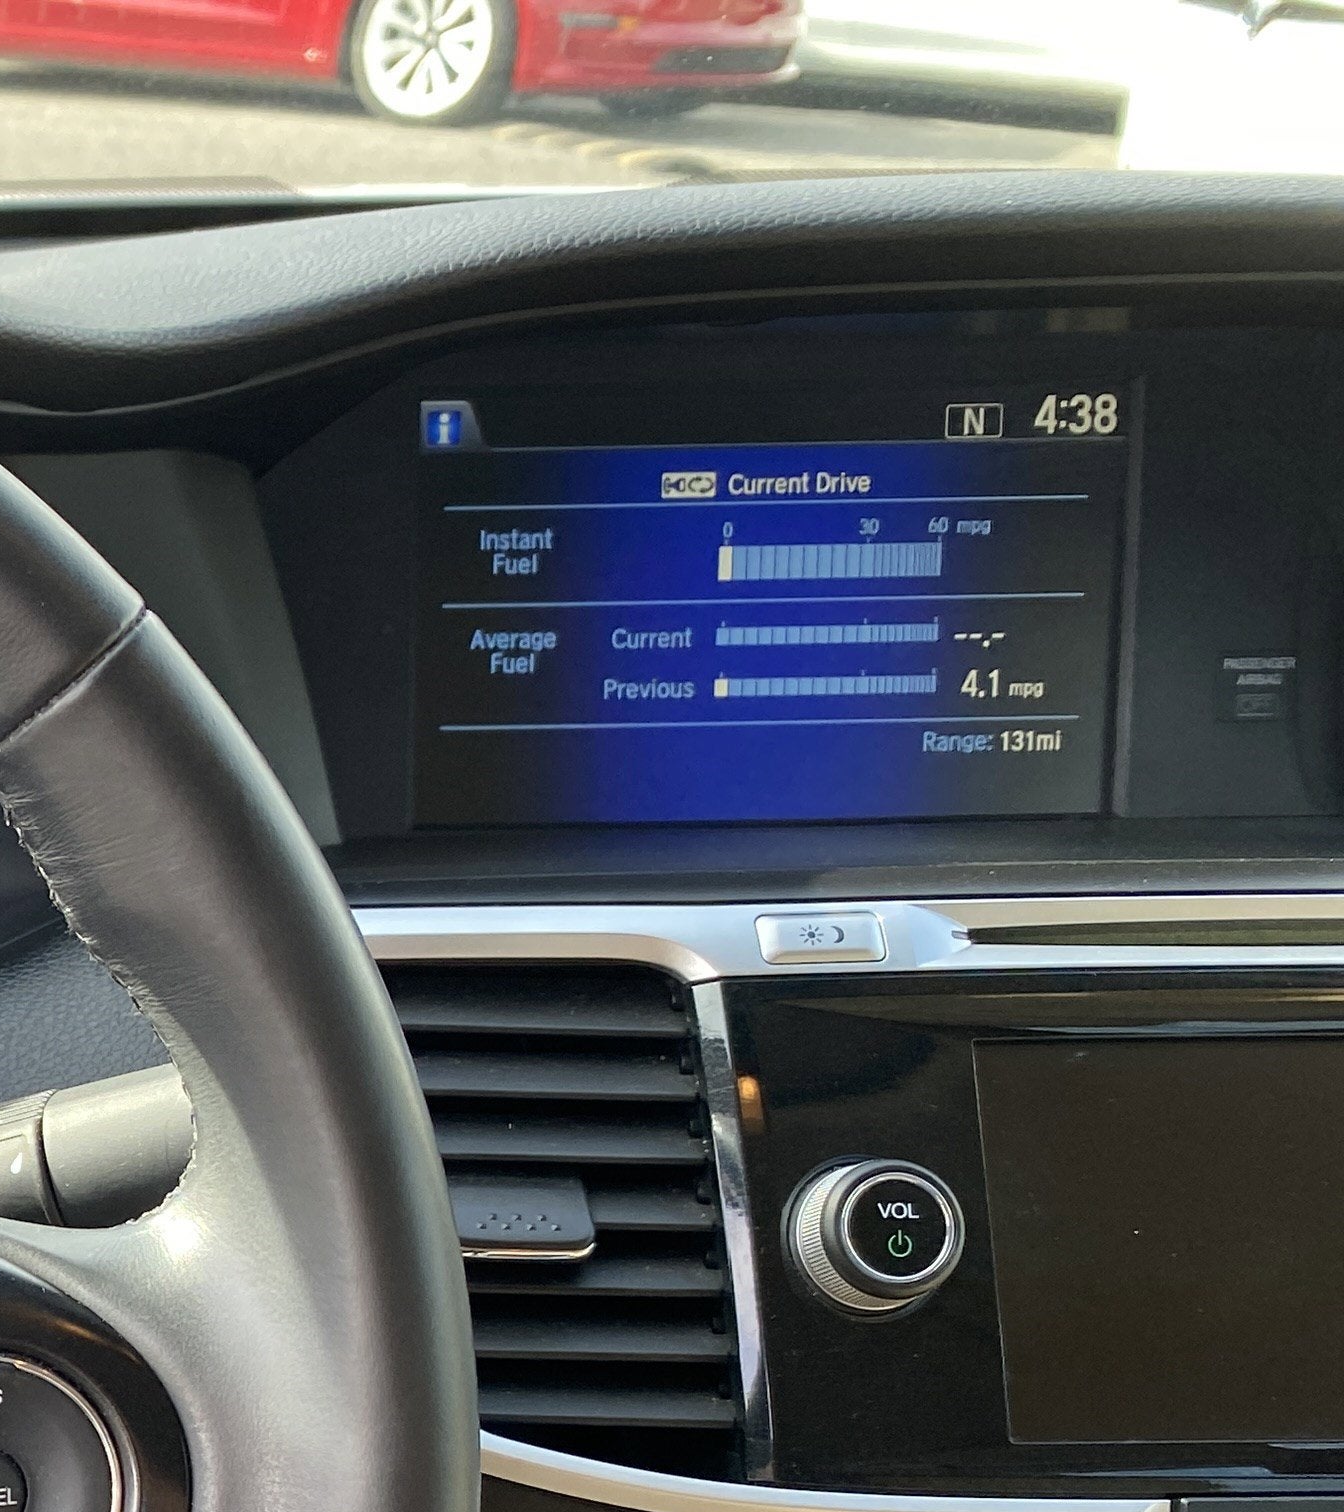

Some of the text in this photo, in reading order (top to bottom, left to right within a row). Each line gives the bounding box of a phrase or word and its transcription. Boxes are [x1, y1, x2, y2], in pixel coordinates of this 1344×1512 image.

[963, 408, 985, 436] N
[1034, 393, 1118, 435] 4:38
[727, 470, 872, 495] Current Drive
[722, 516, 991, 539] 0 30 60 mpg
[479, 528, 553, 552] Instant
[492, 553, 538, 576] Fuel
[470, 628, 557, 653] Average
[611, 627, 692, 650] Current
[490, 652, 536, 675] Fuel
[603, 669, 1044, 701] Previous 4.1 mpg
[922, 729, 993, 755] Range:
[877, 1202, 920, 1219] VOL
